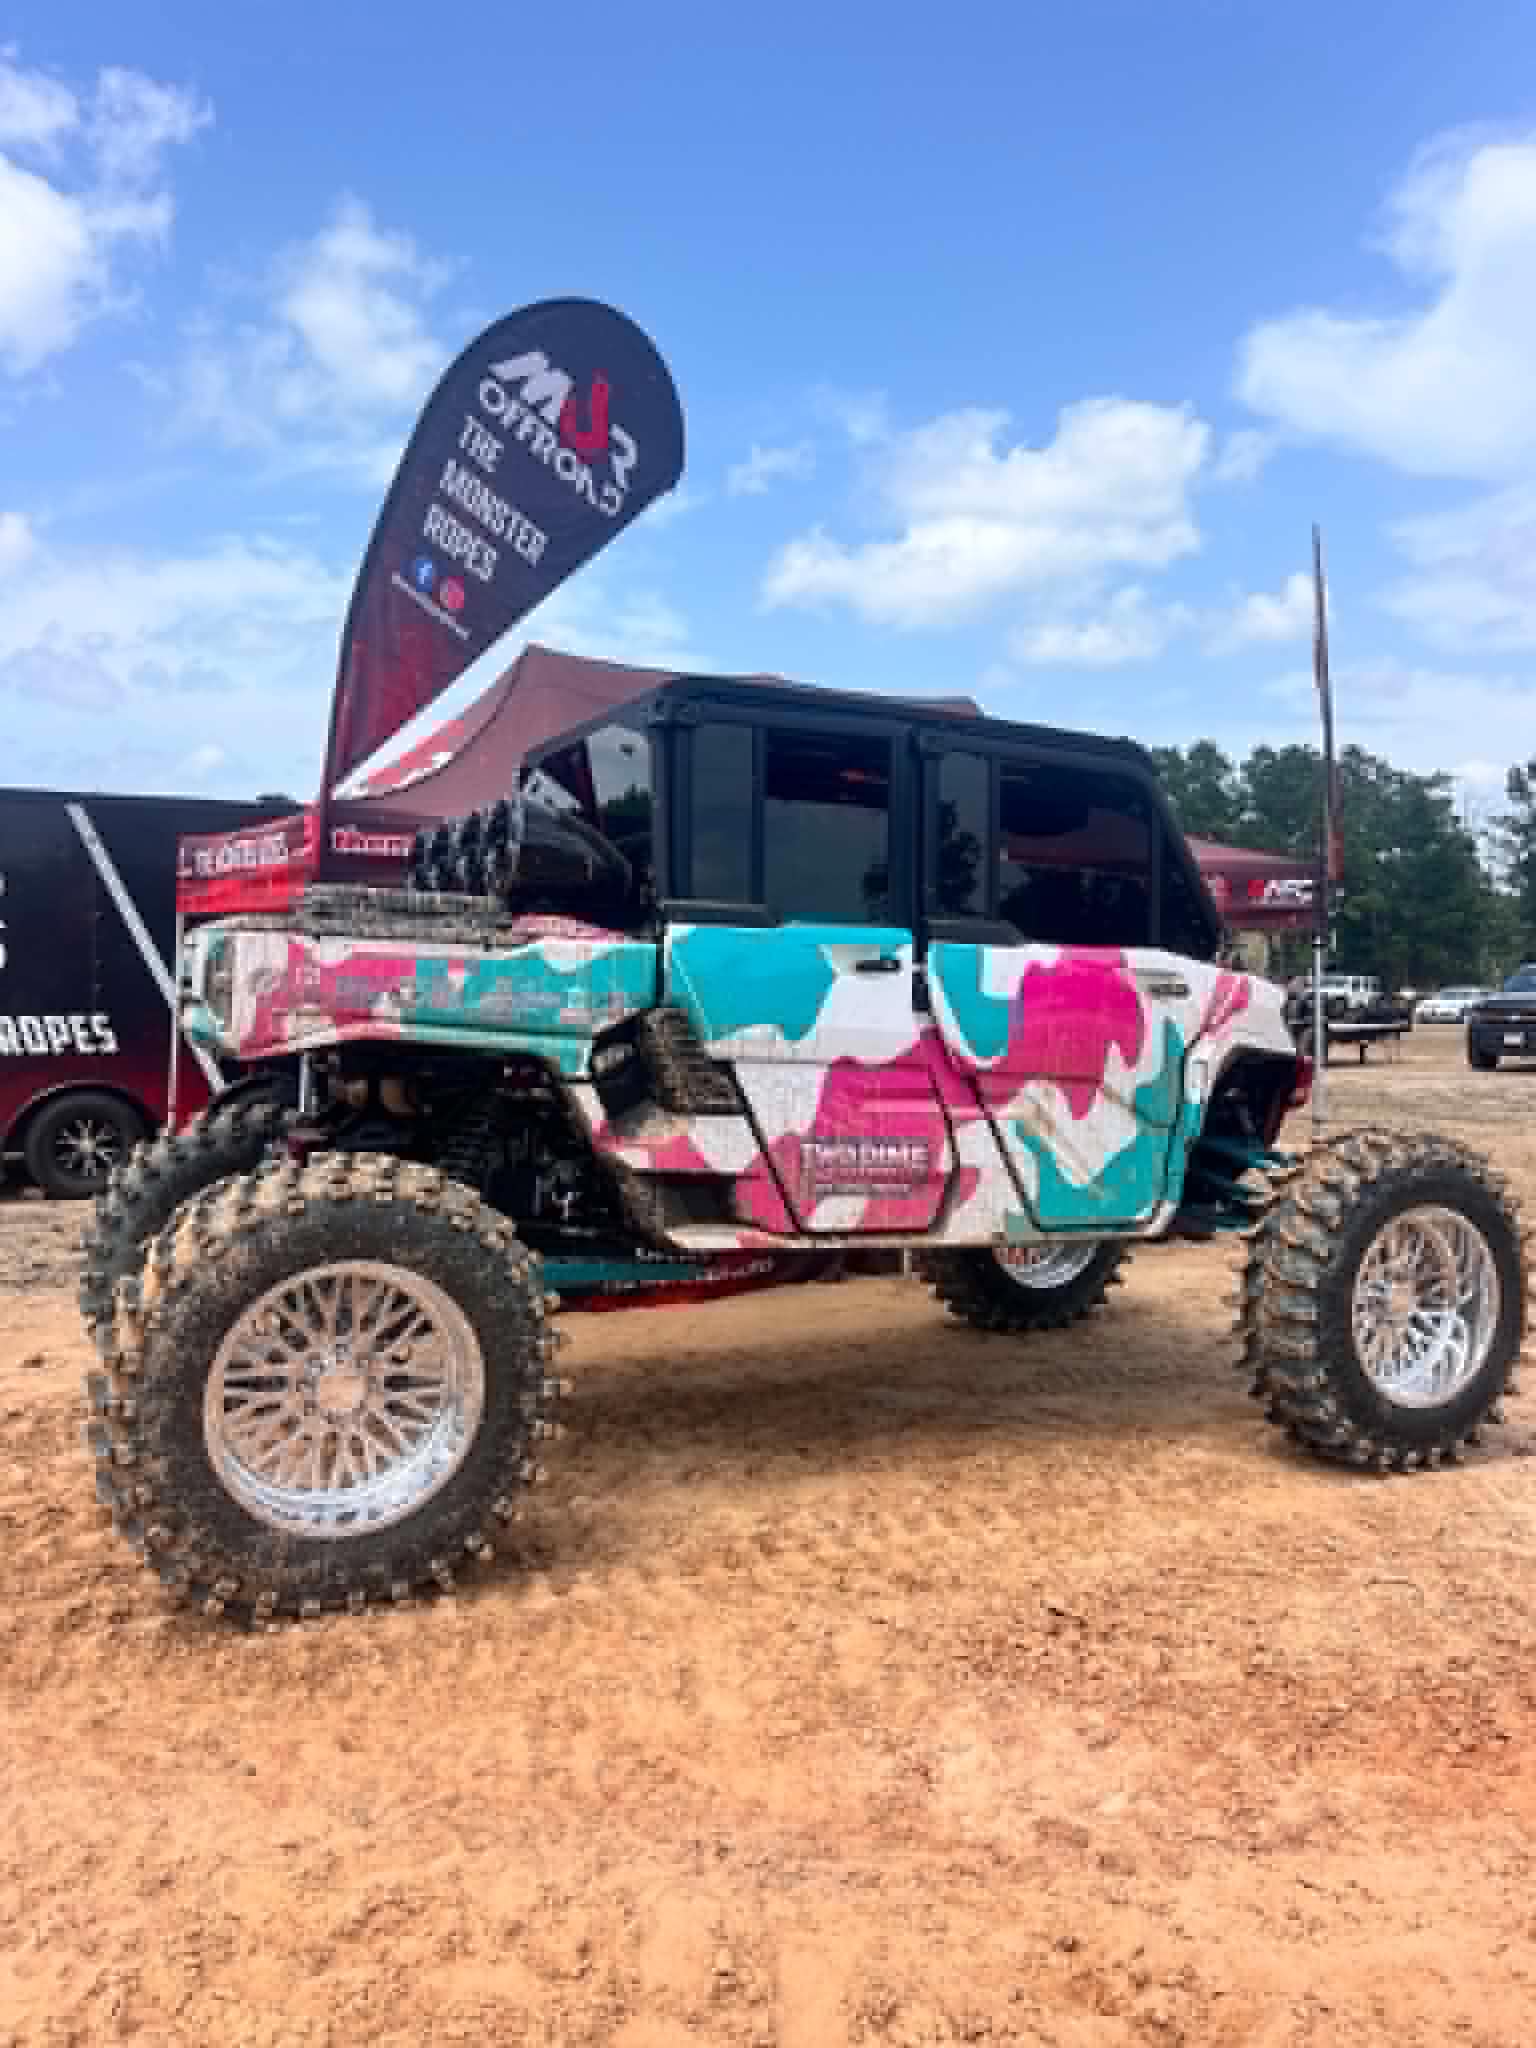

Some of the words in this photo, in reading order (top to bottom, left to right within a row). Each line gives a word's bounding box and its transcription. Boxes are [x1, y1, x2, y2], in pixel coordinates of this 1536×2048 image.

[459, 415, 505, 473] THE
[423, 503, 500, 583] ROPES
[439, 458, 550, 568] MONSTER
